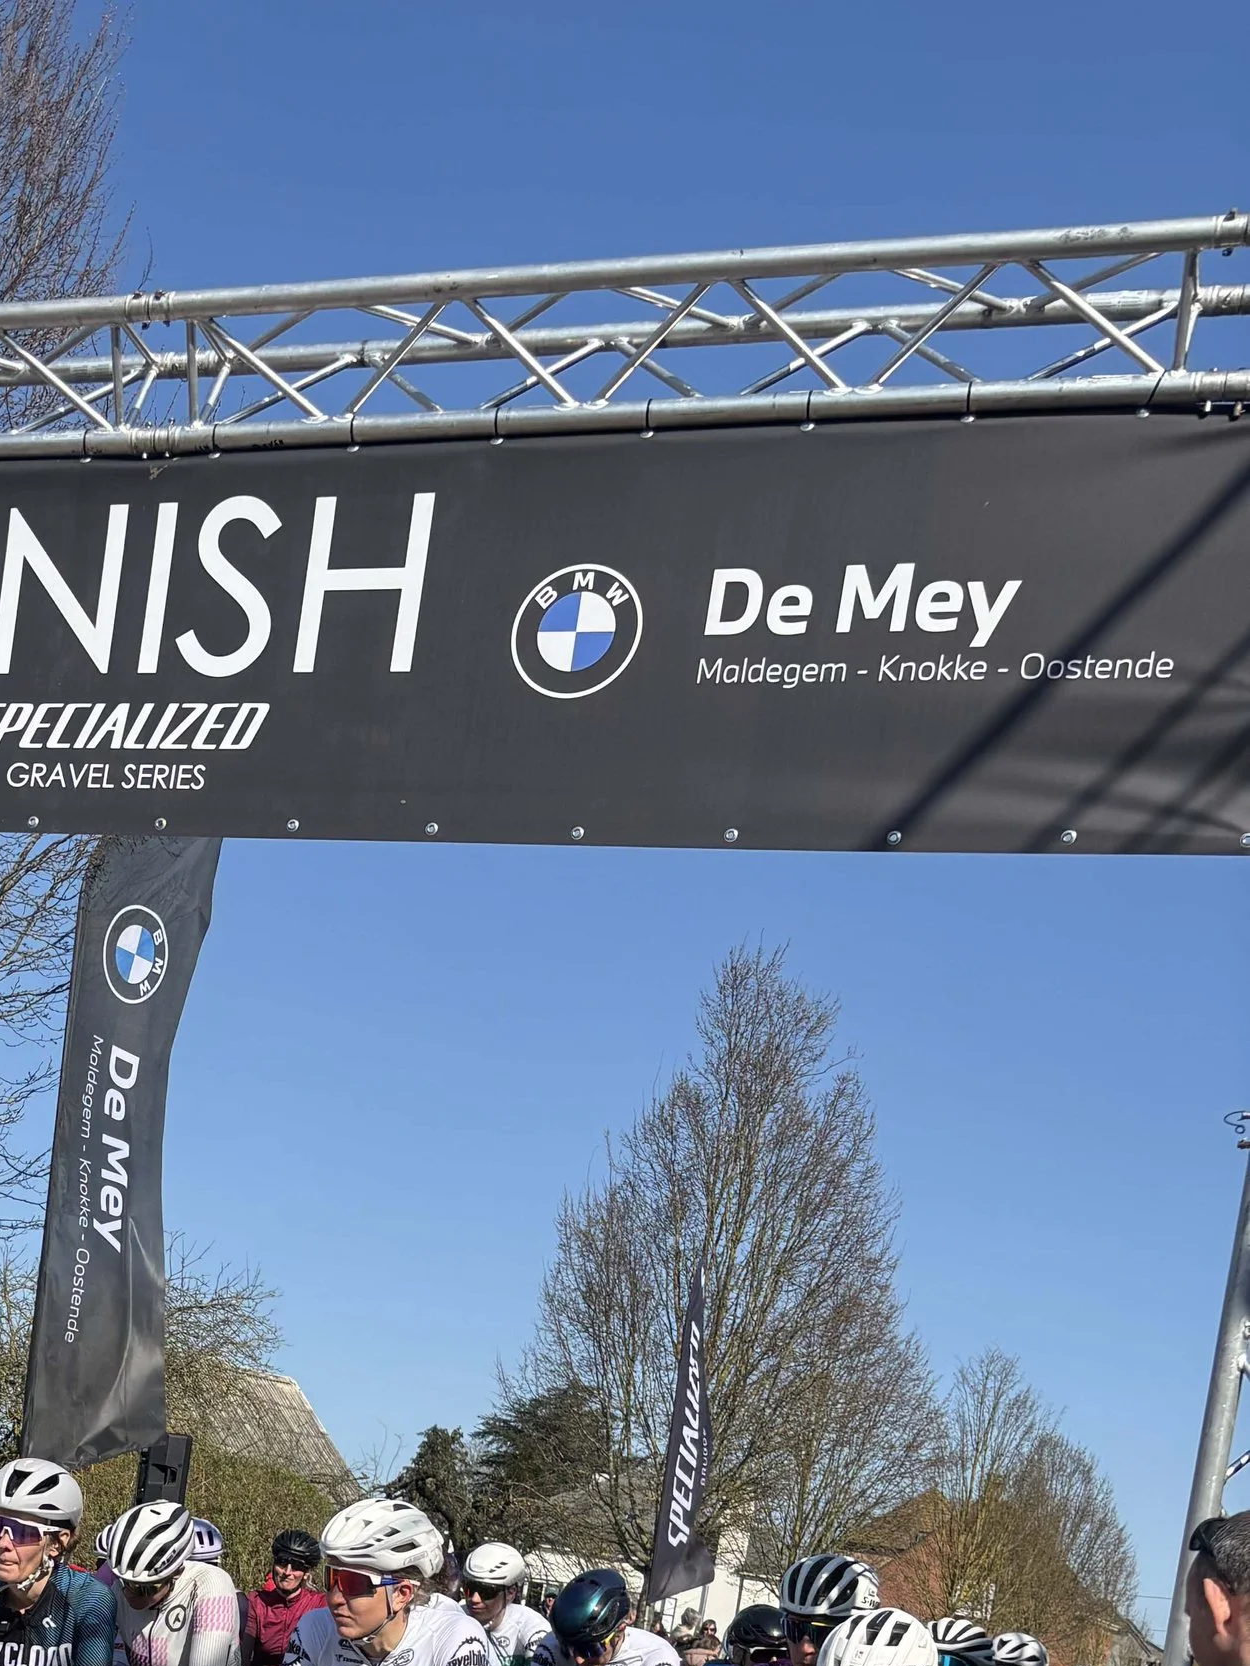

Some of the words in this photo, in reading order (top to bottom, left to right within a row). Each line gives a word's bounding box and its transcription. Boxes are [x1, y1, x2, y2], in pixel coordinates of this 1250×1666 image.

[534, 570, 630, 611] BMW
[703, 567, 814, 637] De
[835, 562, 1023, 647] Mey
[696, 656, 848, 688] Maldegem
[877, 654, 989, 683] Knokke
[1018, 650, 1175, 682] Oostende
[6, 762, 114, 789] GRAVEL
[120, 763, 206, 791] SERIES
[139, 929, 164, 998] BMW
[79, 1034, 105, 1142] Maldegem
[103, 1044, 141, 1115] De
[77, 1157, 93, 1229] Knokke
[92, 1134, 131, 1252] Mey
[63, 1247, 91, 1344] Oostende
[667, 1320, 701, 1548] SPECIALIZED
